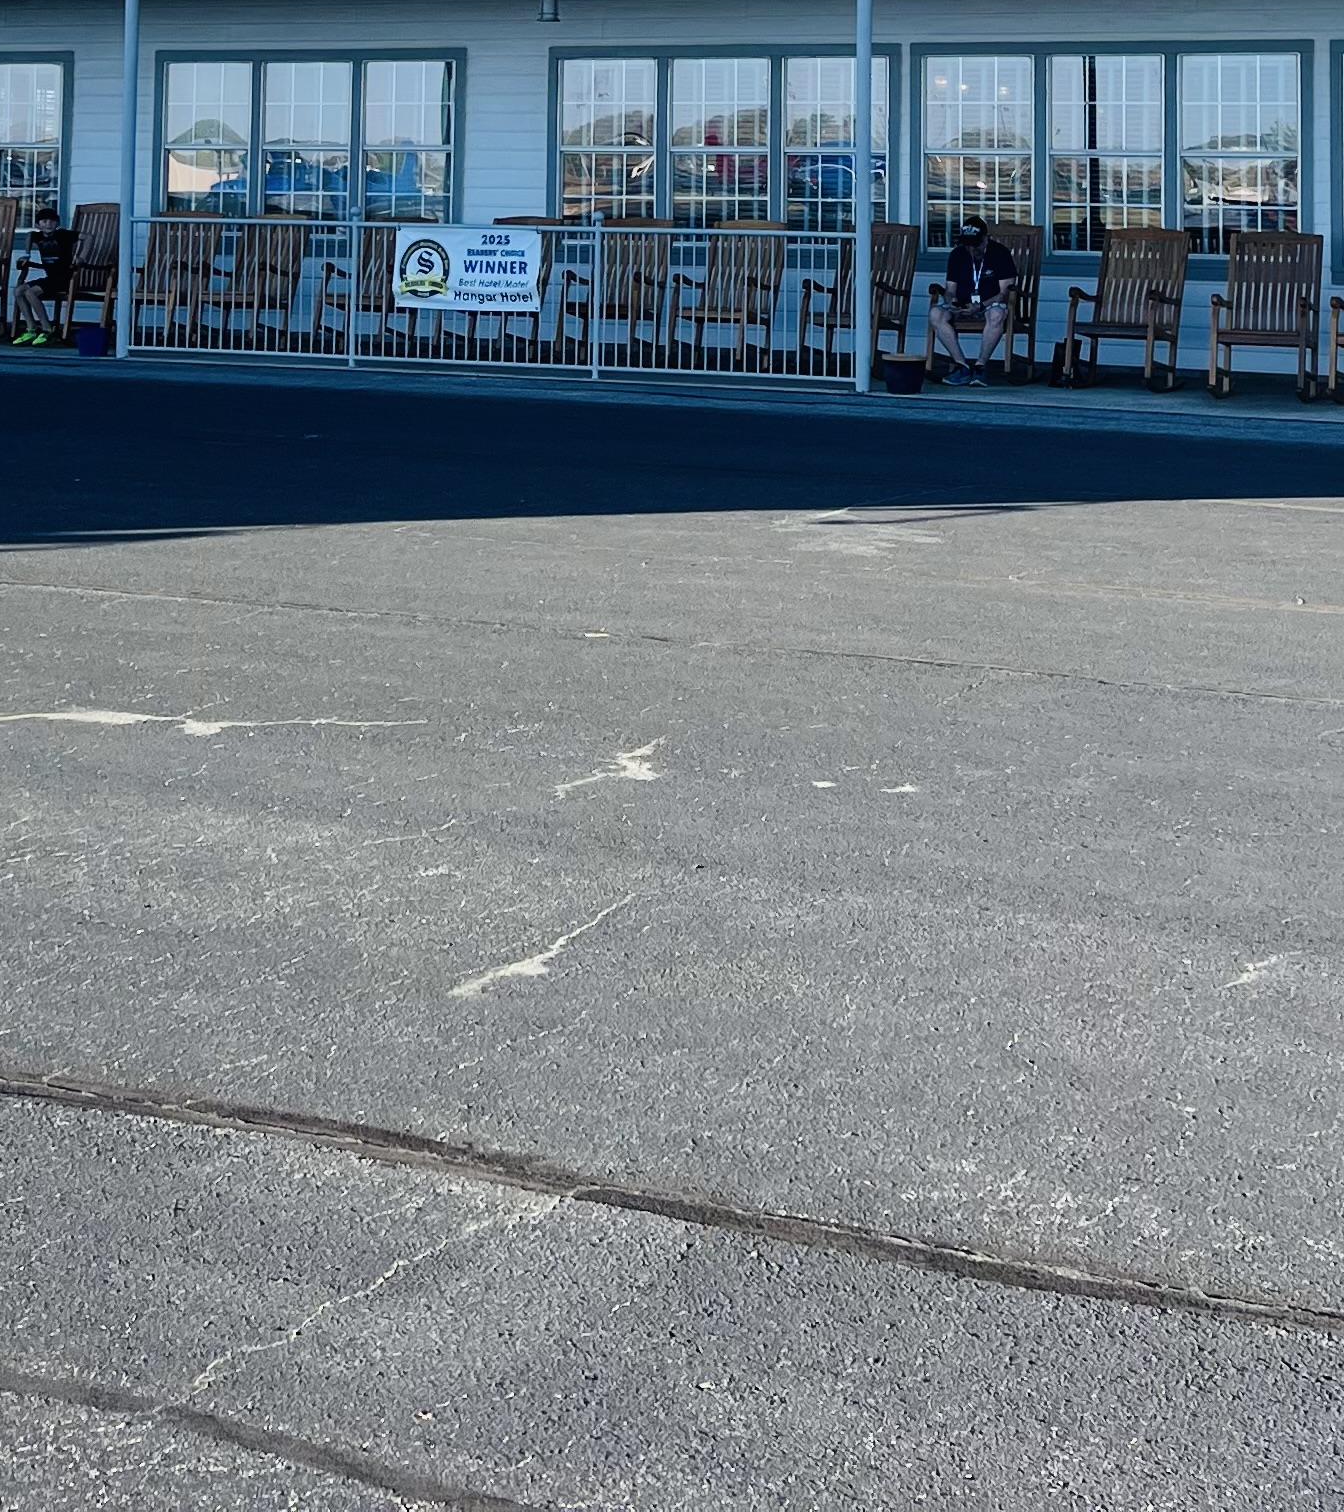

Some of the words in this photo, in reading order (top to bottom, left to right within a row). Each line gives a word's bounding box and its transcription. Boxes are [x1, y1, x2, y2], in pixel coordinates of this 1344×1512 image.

[481, 234, 511, 245] 2025
[416, 250, 435, 275] S
[463, 259, 528, 275] WINNER
[458, 278, 476, 287] Best
[453, 290, 497, 305] Hangar
[499, 291, 533, 303] Hotel
